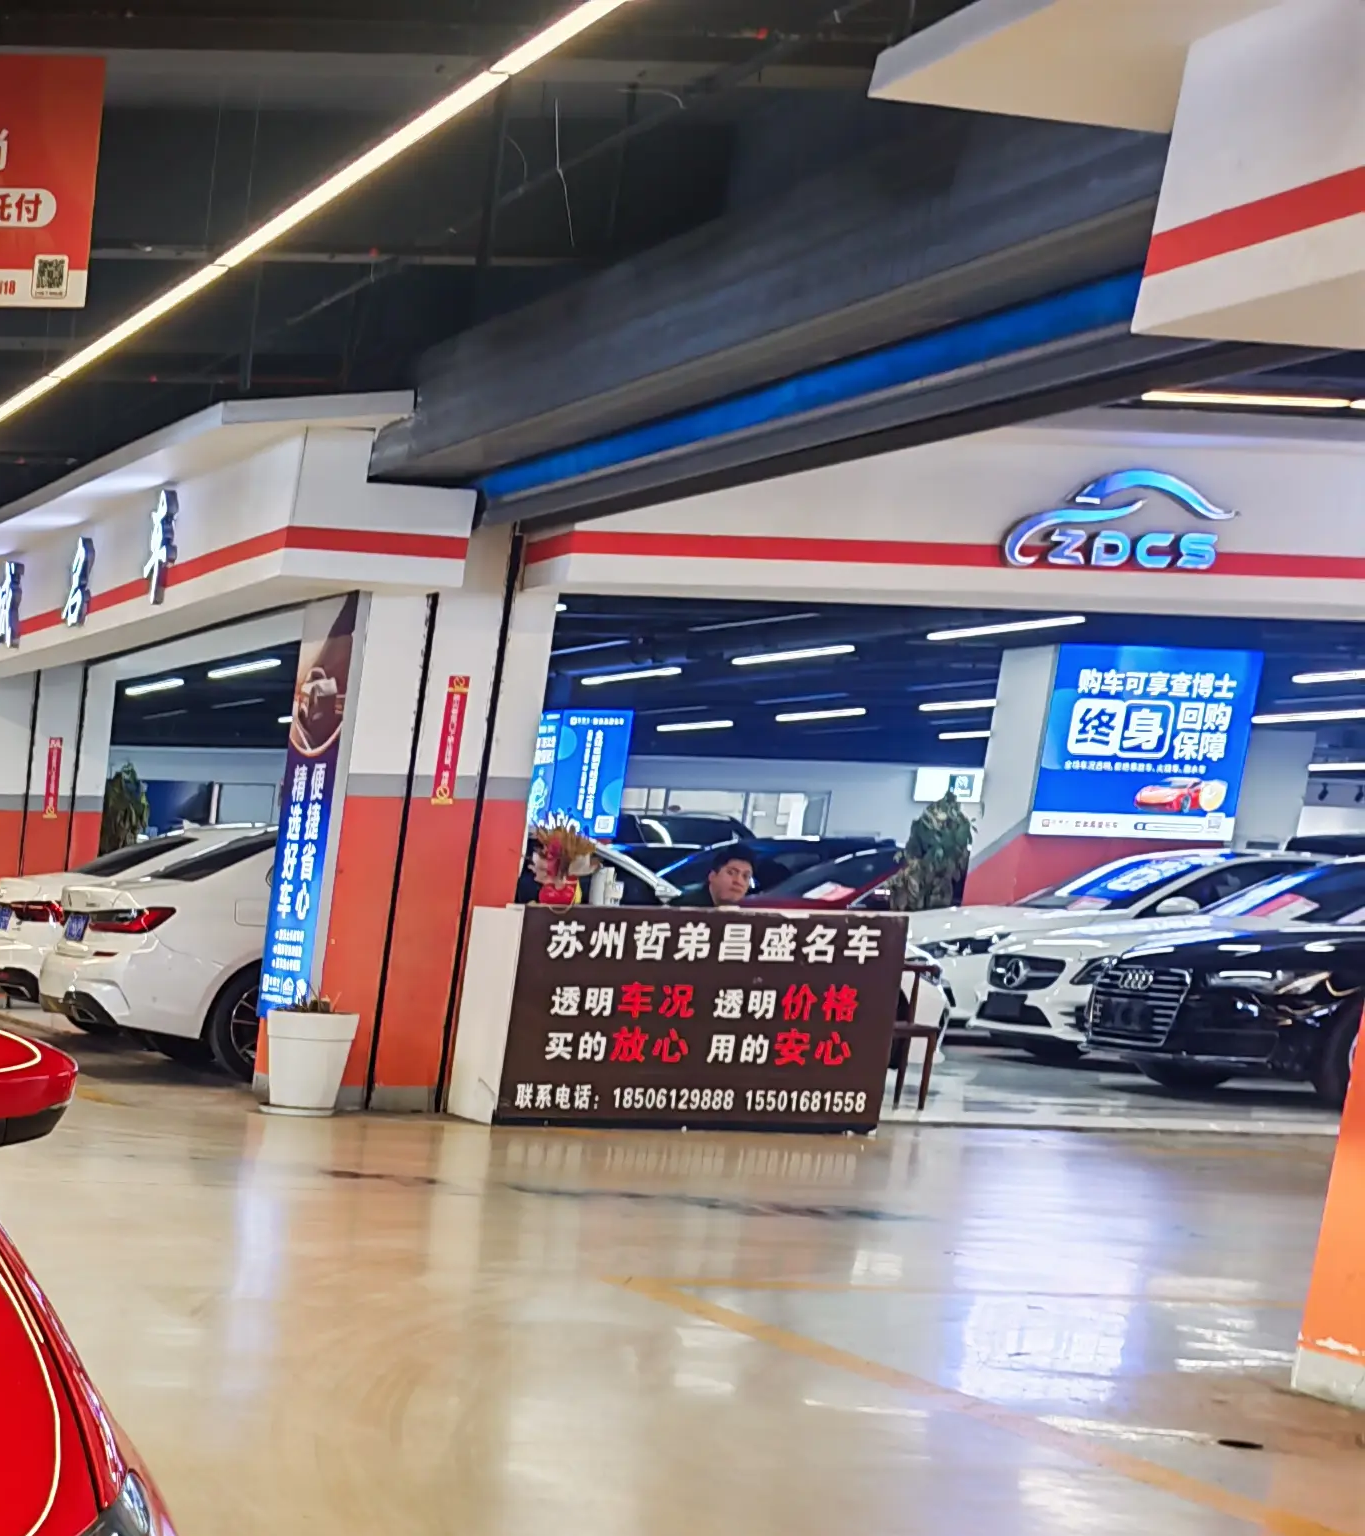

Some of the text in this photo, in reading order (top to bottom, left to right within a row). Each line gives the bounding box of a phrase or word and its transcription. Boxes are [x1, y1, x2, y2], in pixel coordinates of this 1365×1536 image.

[1077, 668, 1237, 699] 购车可享查博士
[1075, 707, 1164, 751] 终身
[1176, 702, 1233, 731] 回购
[1172, 731, 1228, 762] 保障
[277, 764, 308, 919] 精选好车
[295, 763, 327, 920] 便捷省心
[546, 921, 882, 964] 苏州哲弟昌盛名车
[550, 982, 859, 1023] 透明车况 透明价格
[544, 1027, 852, 1066] 买的放心 用的安心
[612, 1086, 734, 1111] 18506129888
[745, 1089, 867, 1113] 15501681558
